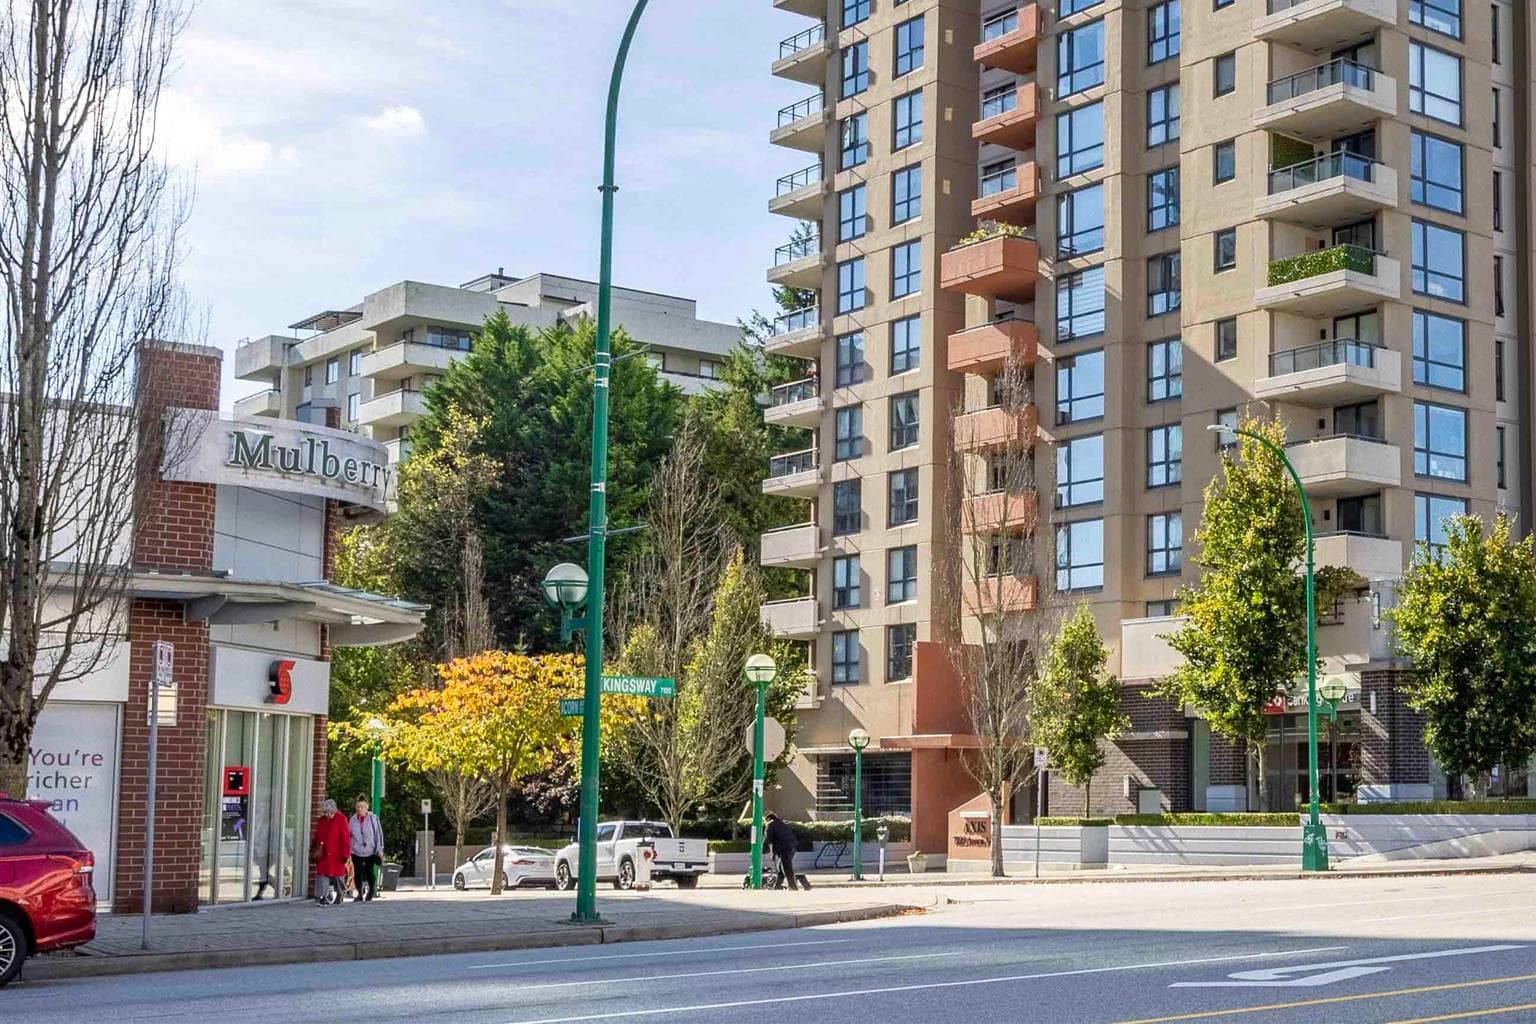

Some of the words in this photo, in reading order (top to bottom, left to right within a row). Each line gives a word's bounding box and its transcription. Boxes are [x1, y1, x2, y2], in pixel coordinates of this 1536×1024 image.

[228, 431, 392, 502] Mulberry
[603, 678, 657, 694] KINGSWAY
[29, 748, 104, 767] You're
[963, 820, 987, 833] AXIS
